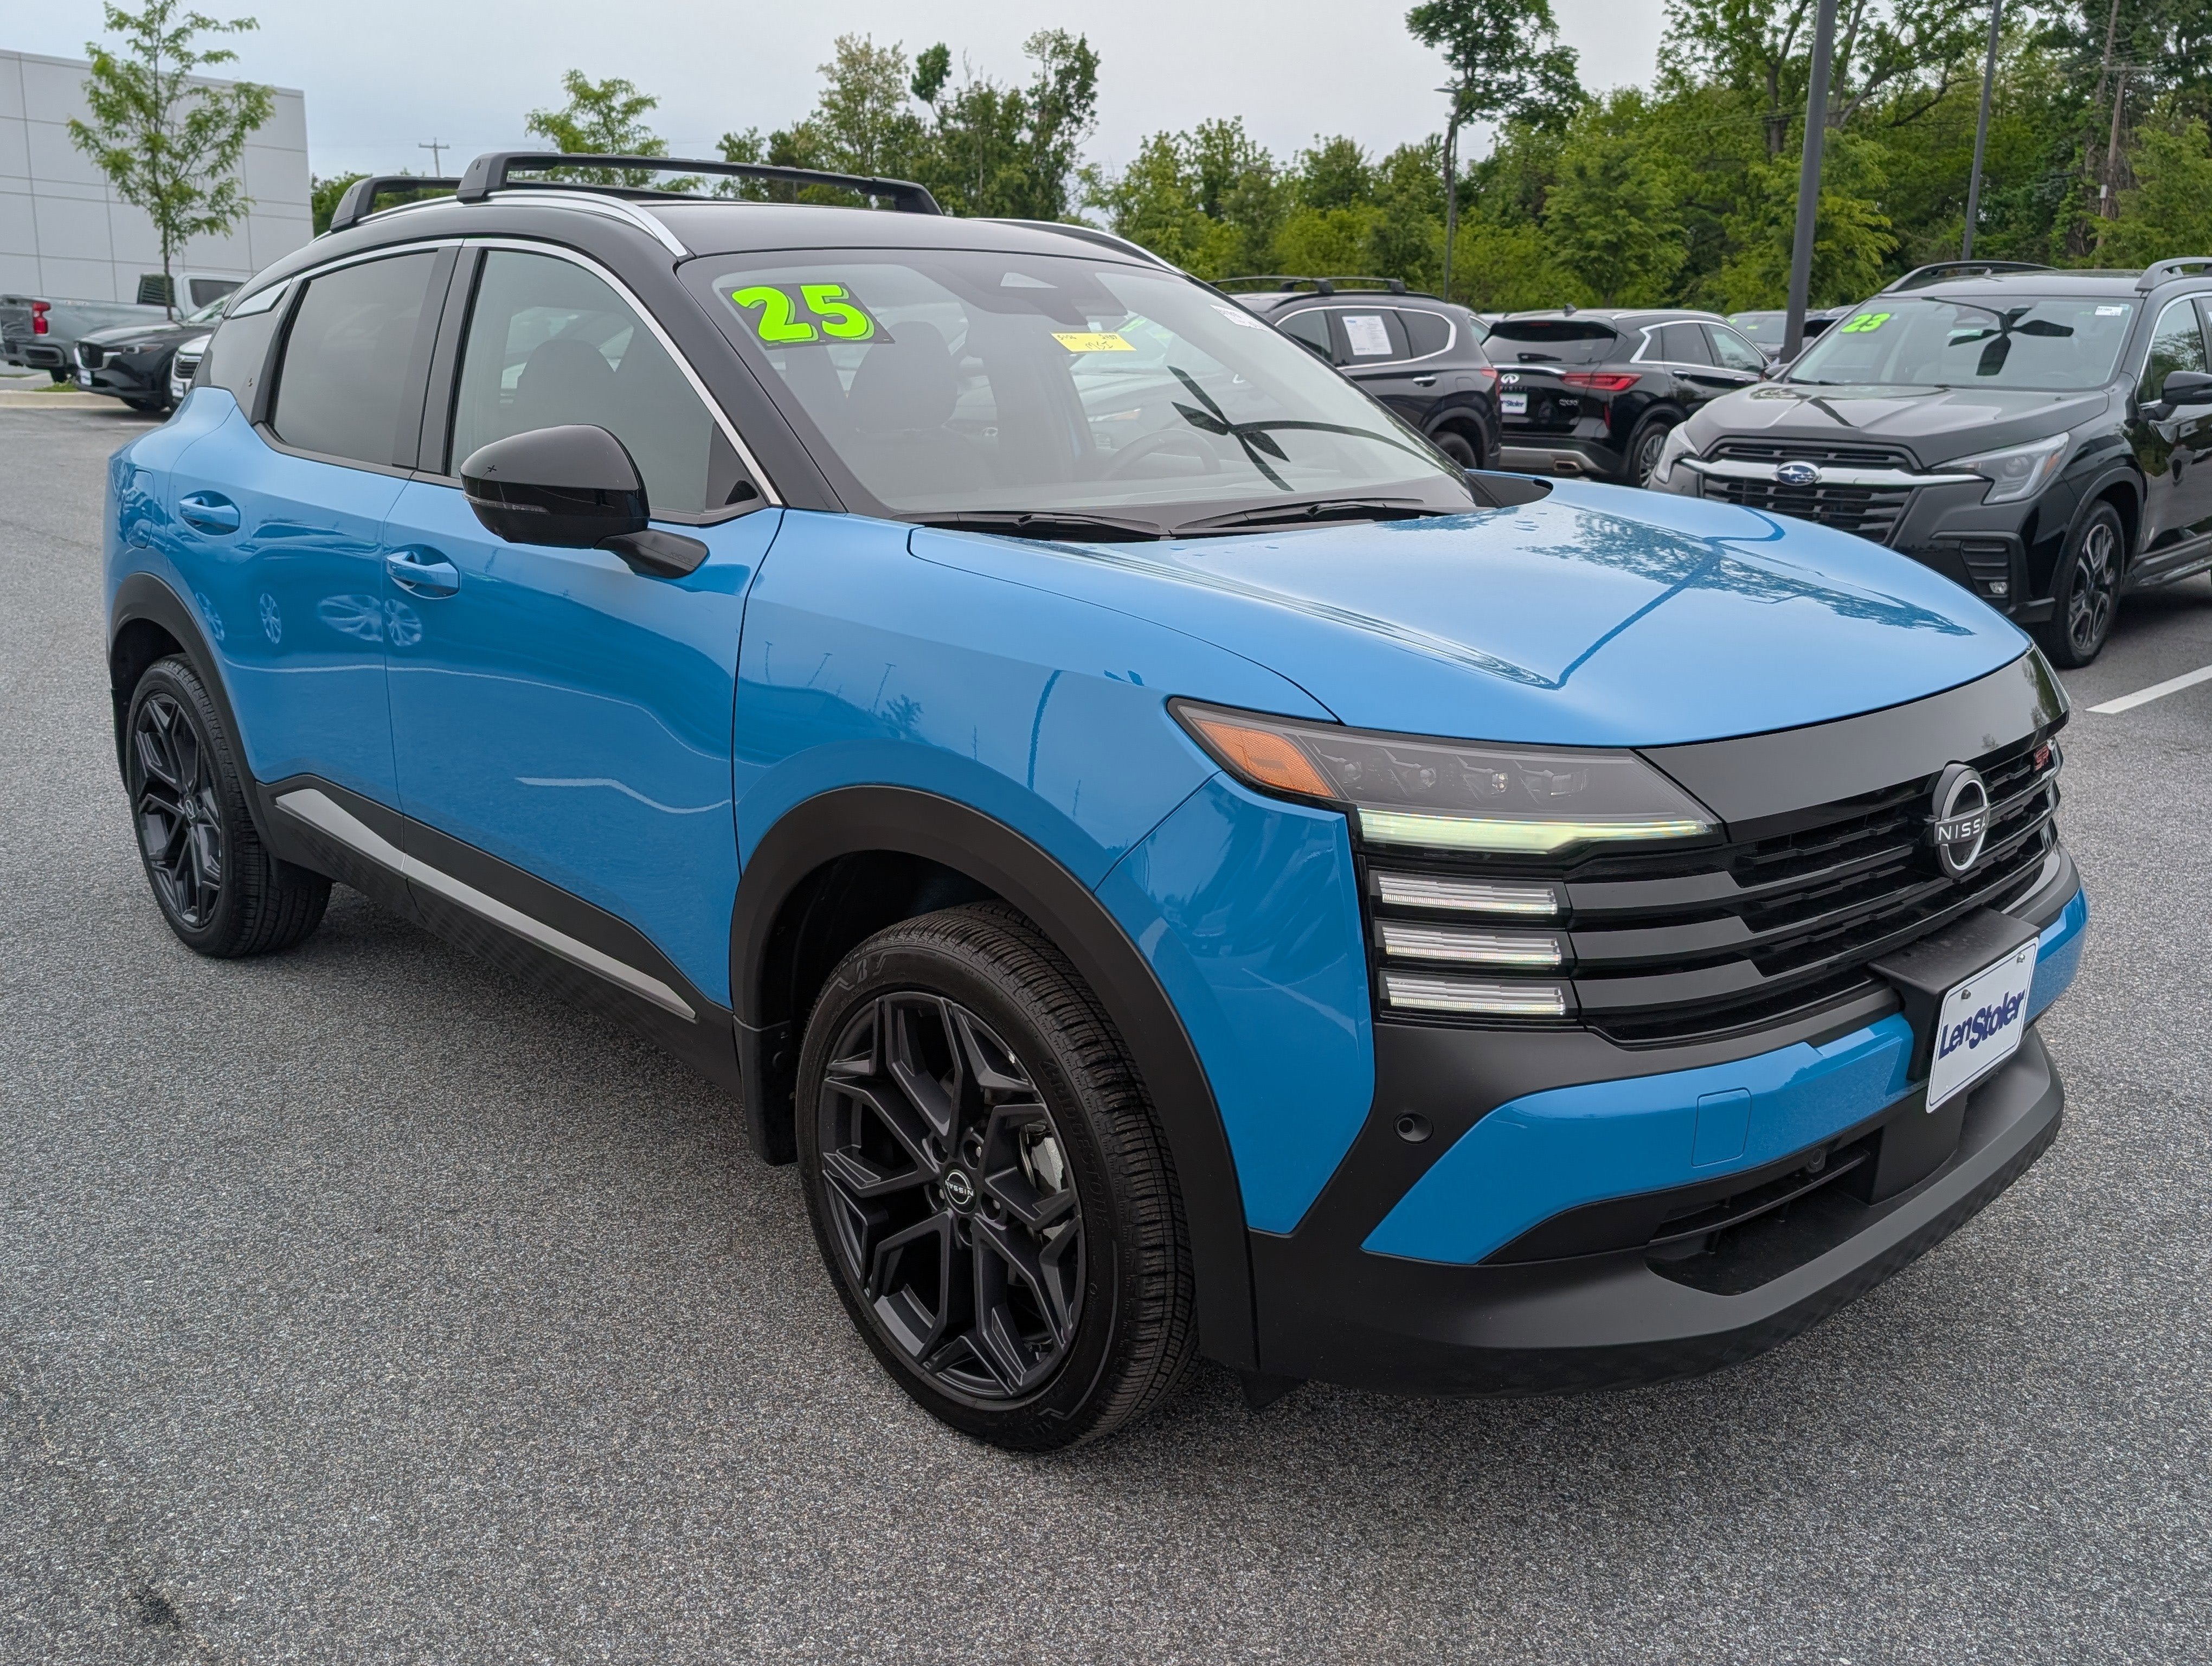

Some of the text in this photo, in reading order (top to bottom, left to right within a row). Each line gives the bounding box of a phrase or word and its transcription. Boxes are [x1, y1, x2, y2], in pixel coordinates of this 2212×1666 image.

[732, 285, 872, 342] 25
[1841, 313, 1891, 332] 23
[1938, 812, 1990, 841] NISSA
